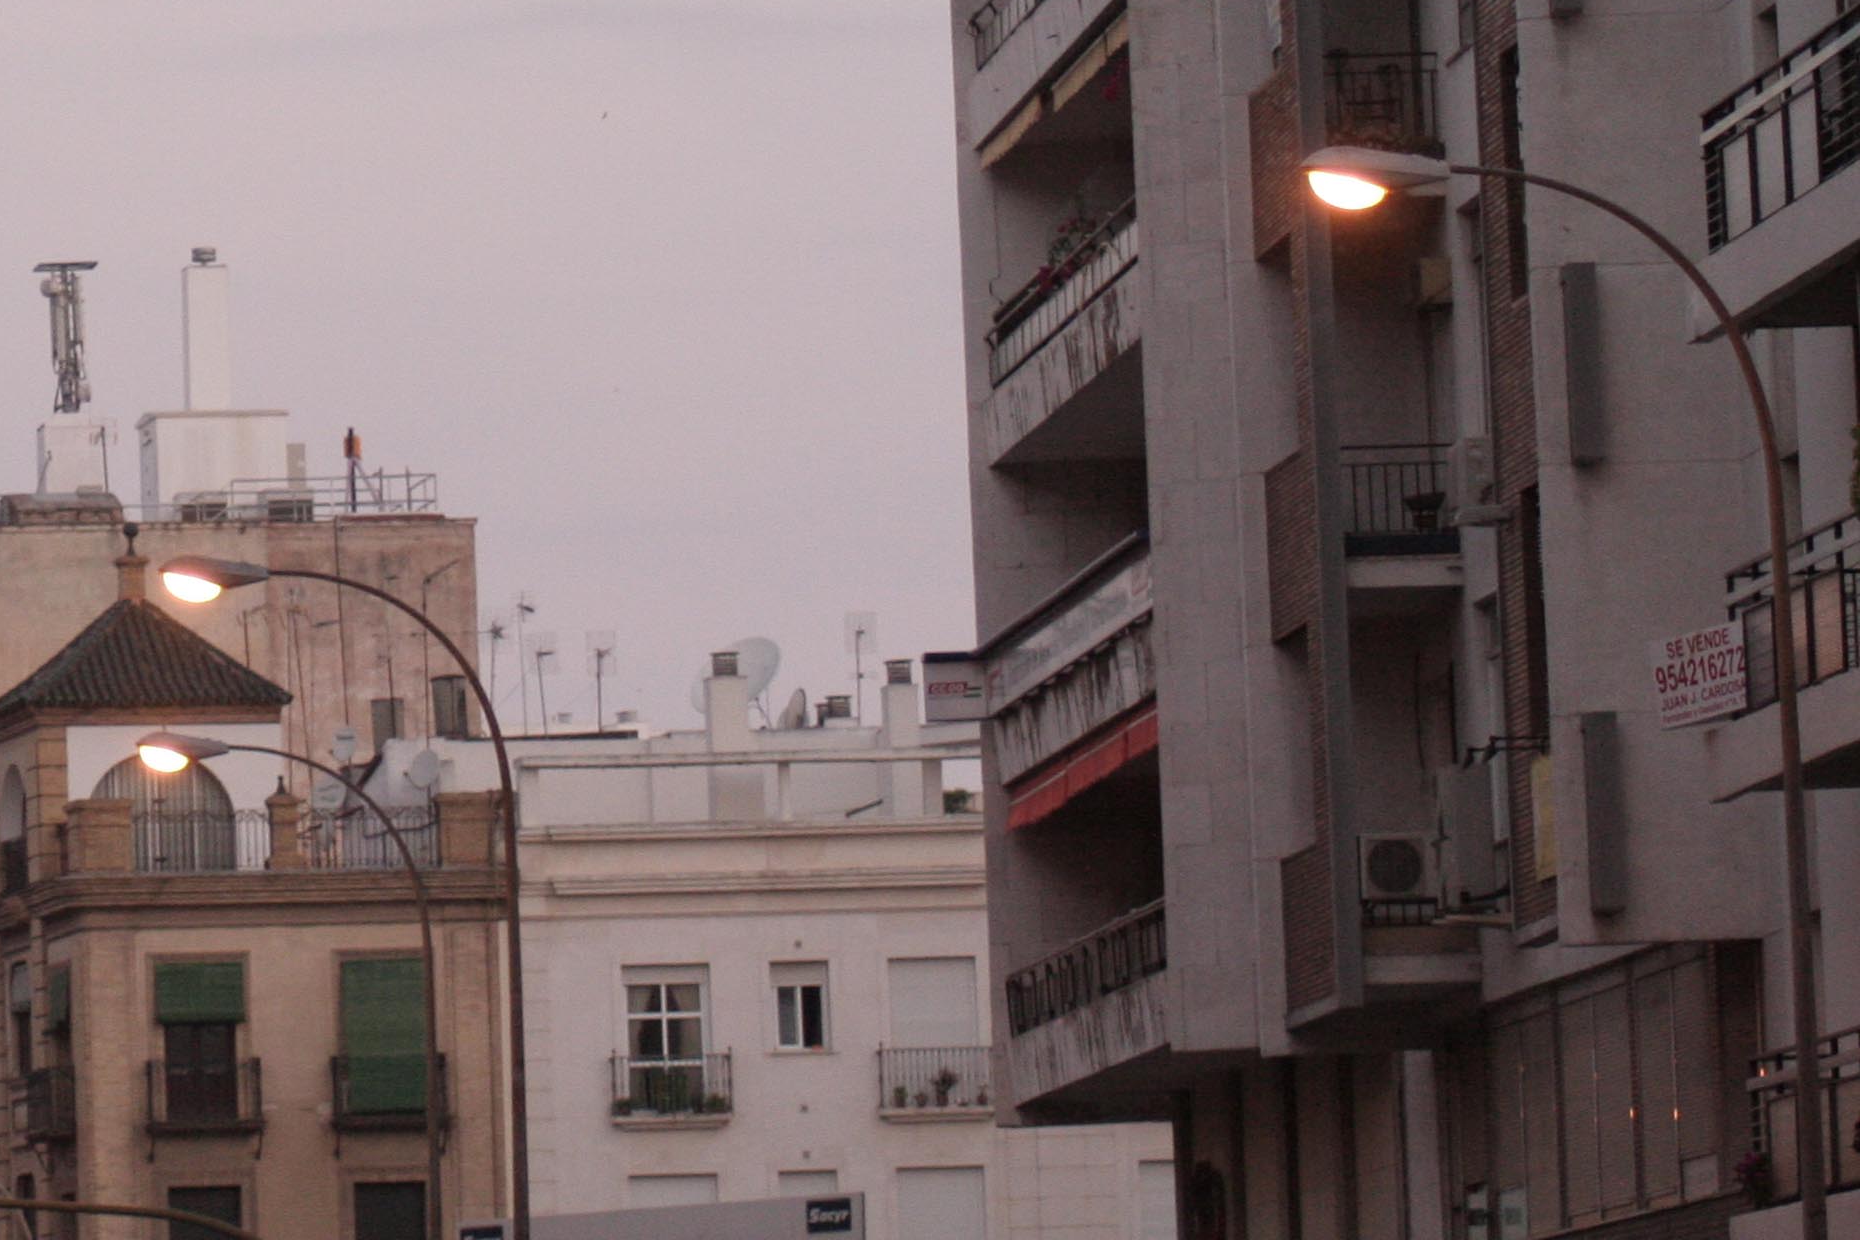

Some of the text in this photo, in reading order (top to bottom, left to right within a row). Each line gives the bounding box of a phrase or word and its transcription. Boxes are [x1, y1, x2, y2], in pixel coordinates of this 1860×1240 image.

[1666, 628, 1730, 659] SE VENDE
[1655, 645, 1746, 693] 954216272
[1662, 694, 1688, 712] JUAN
